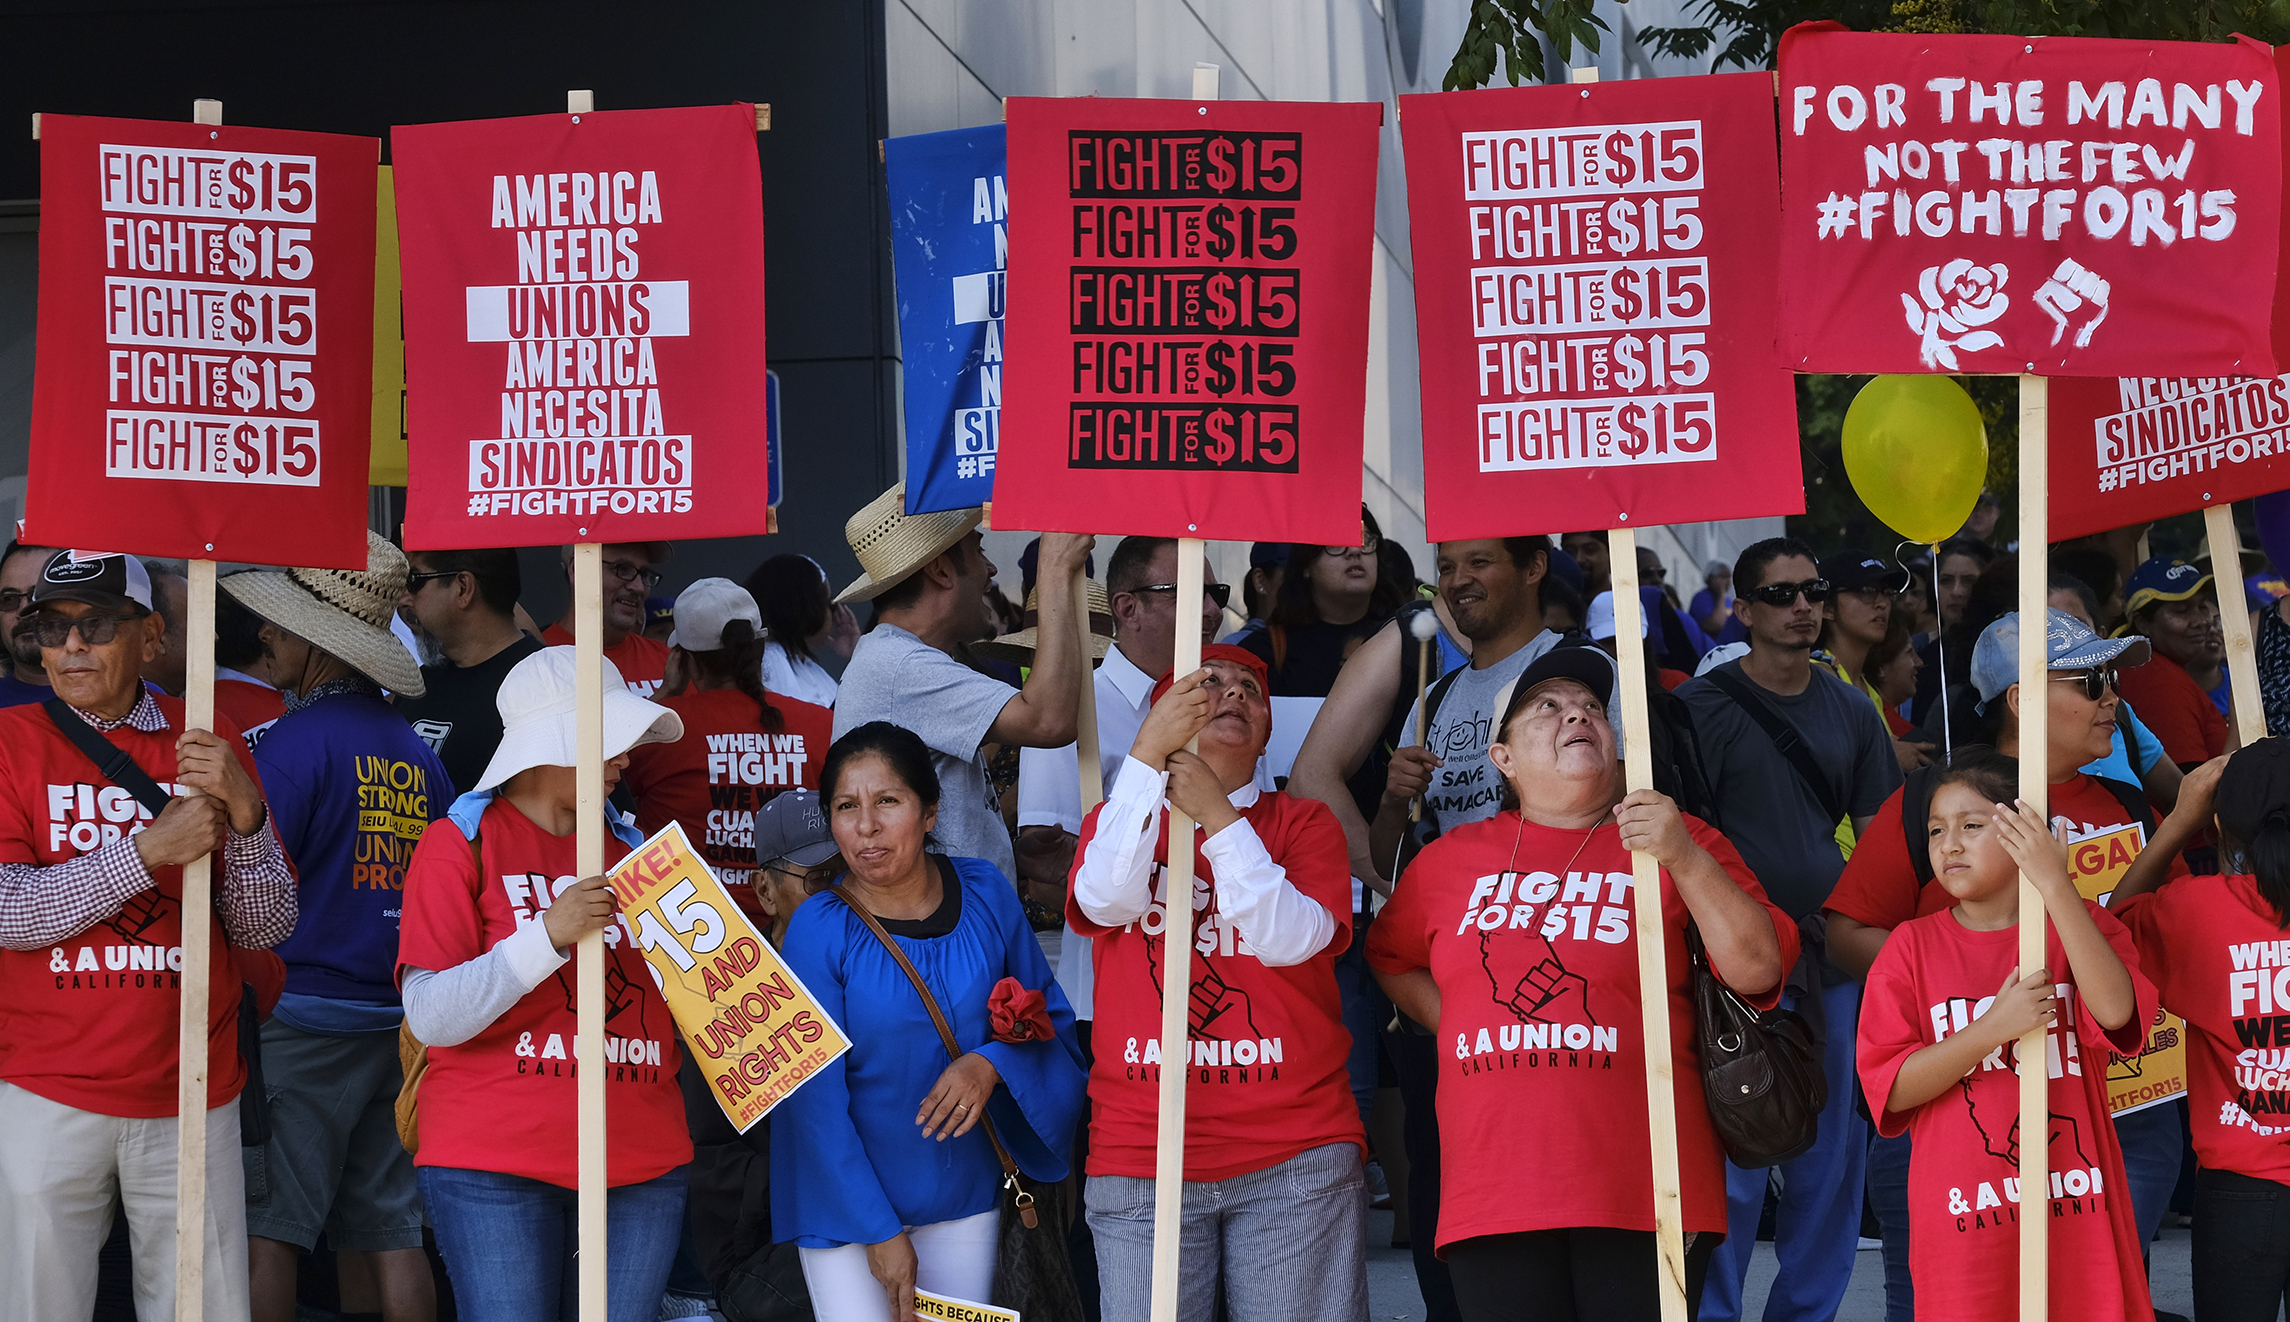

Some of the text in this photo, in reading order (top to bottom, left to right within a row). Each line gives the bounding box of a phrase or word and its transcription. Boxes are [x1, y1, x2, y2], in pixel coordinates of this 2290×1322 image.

[1793, 77, 2264, 137] FOR THE MANY
[104, 152, 312, 214] FIGHT FOR $15
[1071, 135, 1298, 194] FIGHT FOR $15
[1466, 128, 1700, 191] FIGHT FOR $15
[1864, 138, 2195, 187] NOT THE FEW
[492, 171, 662, 228] AMERICA
[1469, 196, 1704, 260] FIGHT FOR $15
[1816, 184, 2237, 247] #FIGHTFOR15
[105, 217, 313, 281] FIGHT FOR $15
[517, 228, 639, 284] NEEDS
[1073, 203, 1298, 262] FIGHT FOR $15
[110, 284, 312, 346] FIGHT FOR $15
[508, 283, 650, 338] UNIONS
[1073, 271, 1297, 330] FIGHT FOR $15
[1475, 265, 1706, 327] FIGHT FOR $15
[110, 350, 315, 412] FIGHT FOR $15
[506, 338, 657, 388] AMERICA
[1073, 339, 1297, 398] FIGHT FOR $15
[1478, 332, 1710, 396] FIGHT FOR $15
[502, 389, 664, 439] NECESITA
[1071, 407, 1296, 467] FIGHT FOR $15
[1481, 400, 1712, 463] FIGHT FOR $15
[2105, 378, 2290, 462] SINDICATOS
[110, 417, 316, 478] FIGHT FOR $15
[480, 439, 683, 489] SINDICATOS
[2099, 428, 2290, 492] #FIGHTFOR1
[467, 490, 693, 516] #FIGHTFOR15
[705, 734, 805, 753] WHEN WE
[707, 753, 807, 785] FIGHT
[355, 756, 426, 793] UNION
[709, 786, 752, 809] WE
[1441, 765, 1483, 787] SAVE
[362, 816, 386, 827] SEIU
[407, 824, 423, 836] 99
[1468, 871, 1634, 910] FIGHT
[1457, 903, 1630, 944] FOR $15
[50, 947, 70, 973] &
[75, 946, 100, 972] A
[701, 937, 761, 1002] AND
[695, 972, 795, 1059] UNION
[1456, 1023, 1617, 1059] & A UNION
[515, 1031, 535, 1058] &
[541, 1033, 566, 1060] A
[716, 1011, 823, 1106] RIGHTS
[1124, 1037, 1139, 1064] &
[1142, 1039, 1162, 1065] A
[1462, 1052, 1611, 1076] CALIFORNIA
[739, 1047, 828, 1122] #FIGHTFOR15
[1948, 1187, 1971, 1215] &
[1976, 1181, 2002, 1211] A
